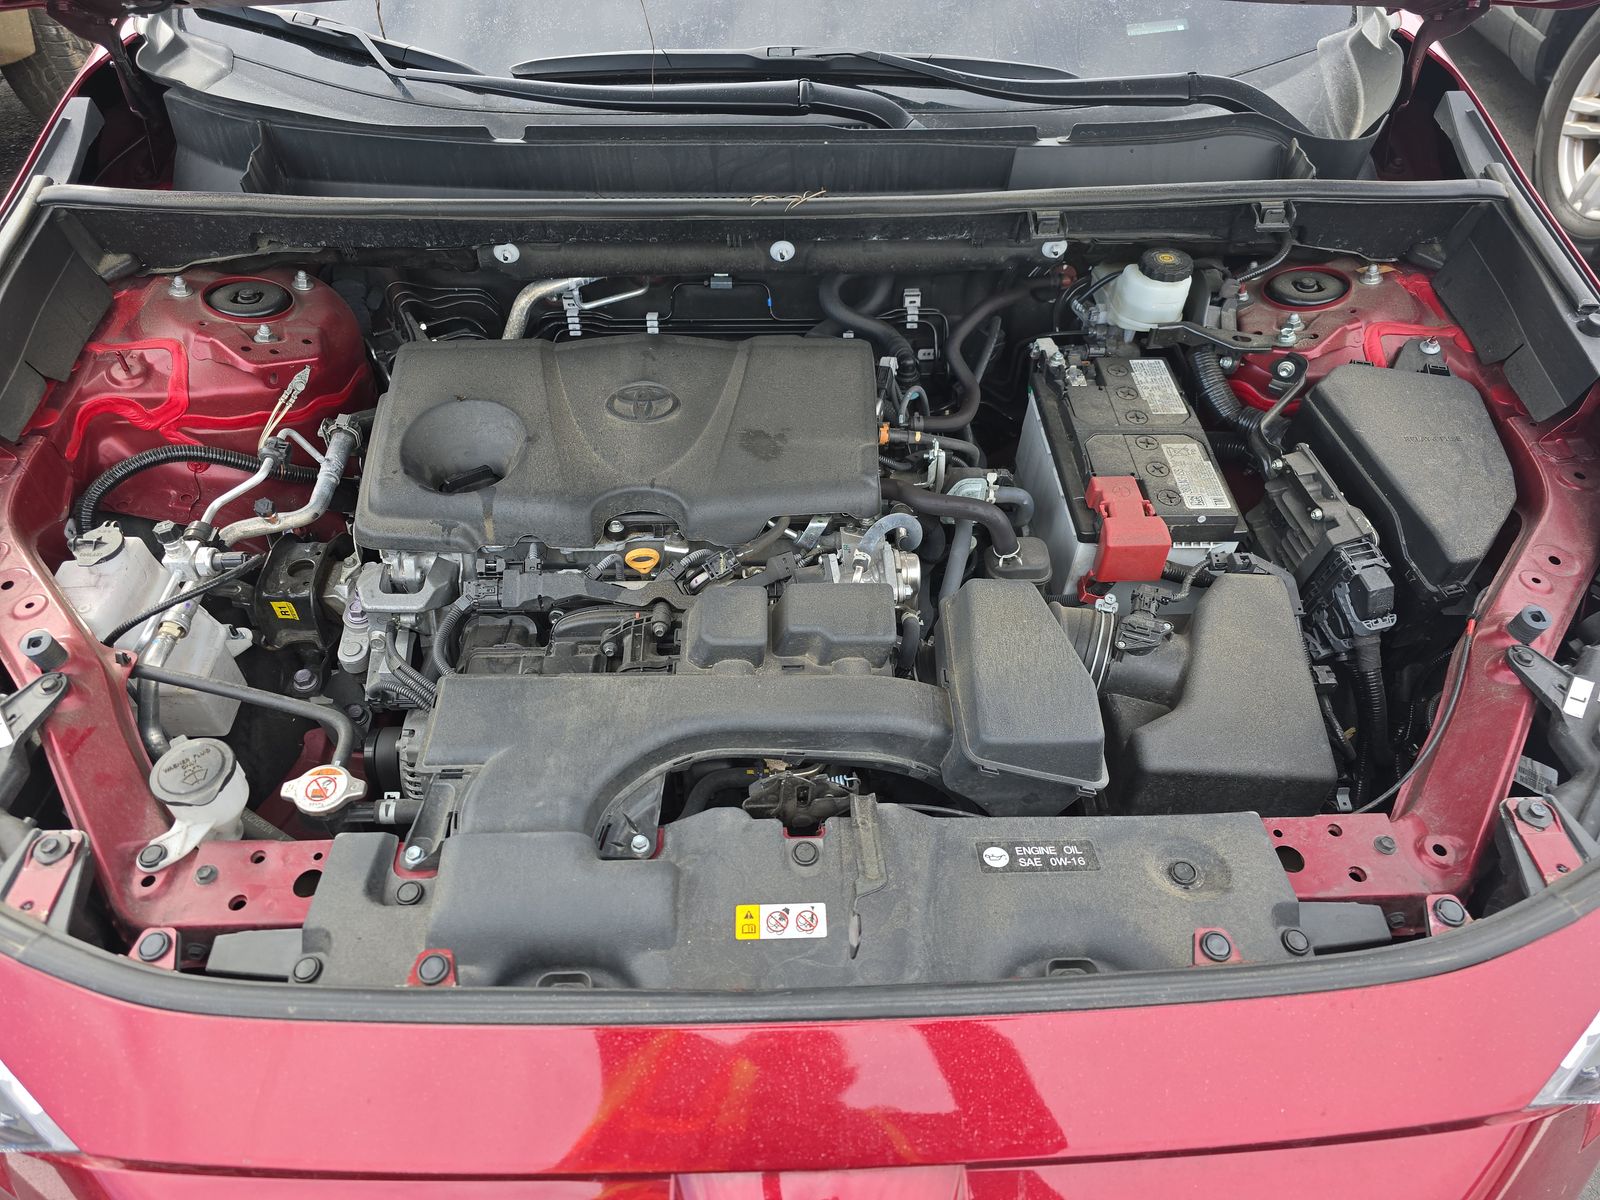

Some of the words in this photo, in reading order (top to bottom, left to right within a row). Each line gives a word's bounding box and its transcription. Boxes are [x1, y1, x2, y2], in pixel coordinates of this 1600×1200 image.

[278, 606, 290, 616] R1
[1569, 696, 1587, 704] L
[1014, 846, 1057, 856] ENGINE
[1063, 845, 1083, 855] OIL
[1018, 857, 1042, 867] SAE
[1049, 857, 1086, 866] 0W-16
